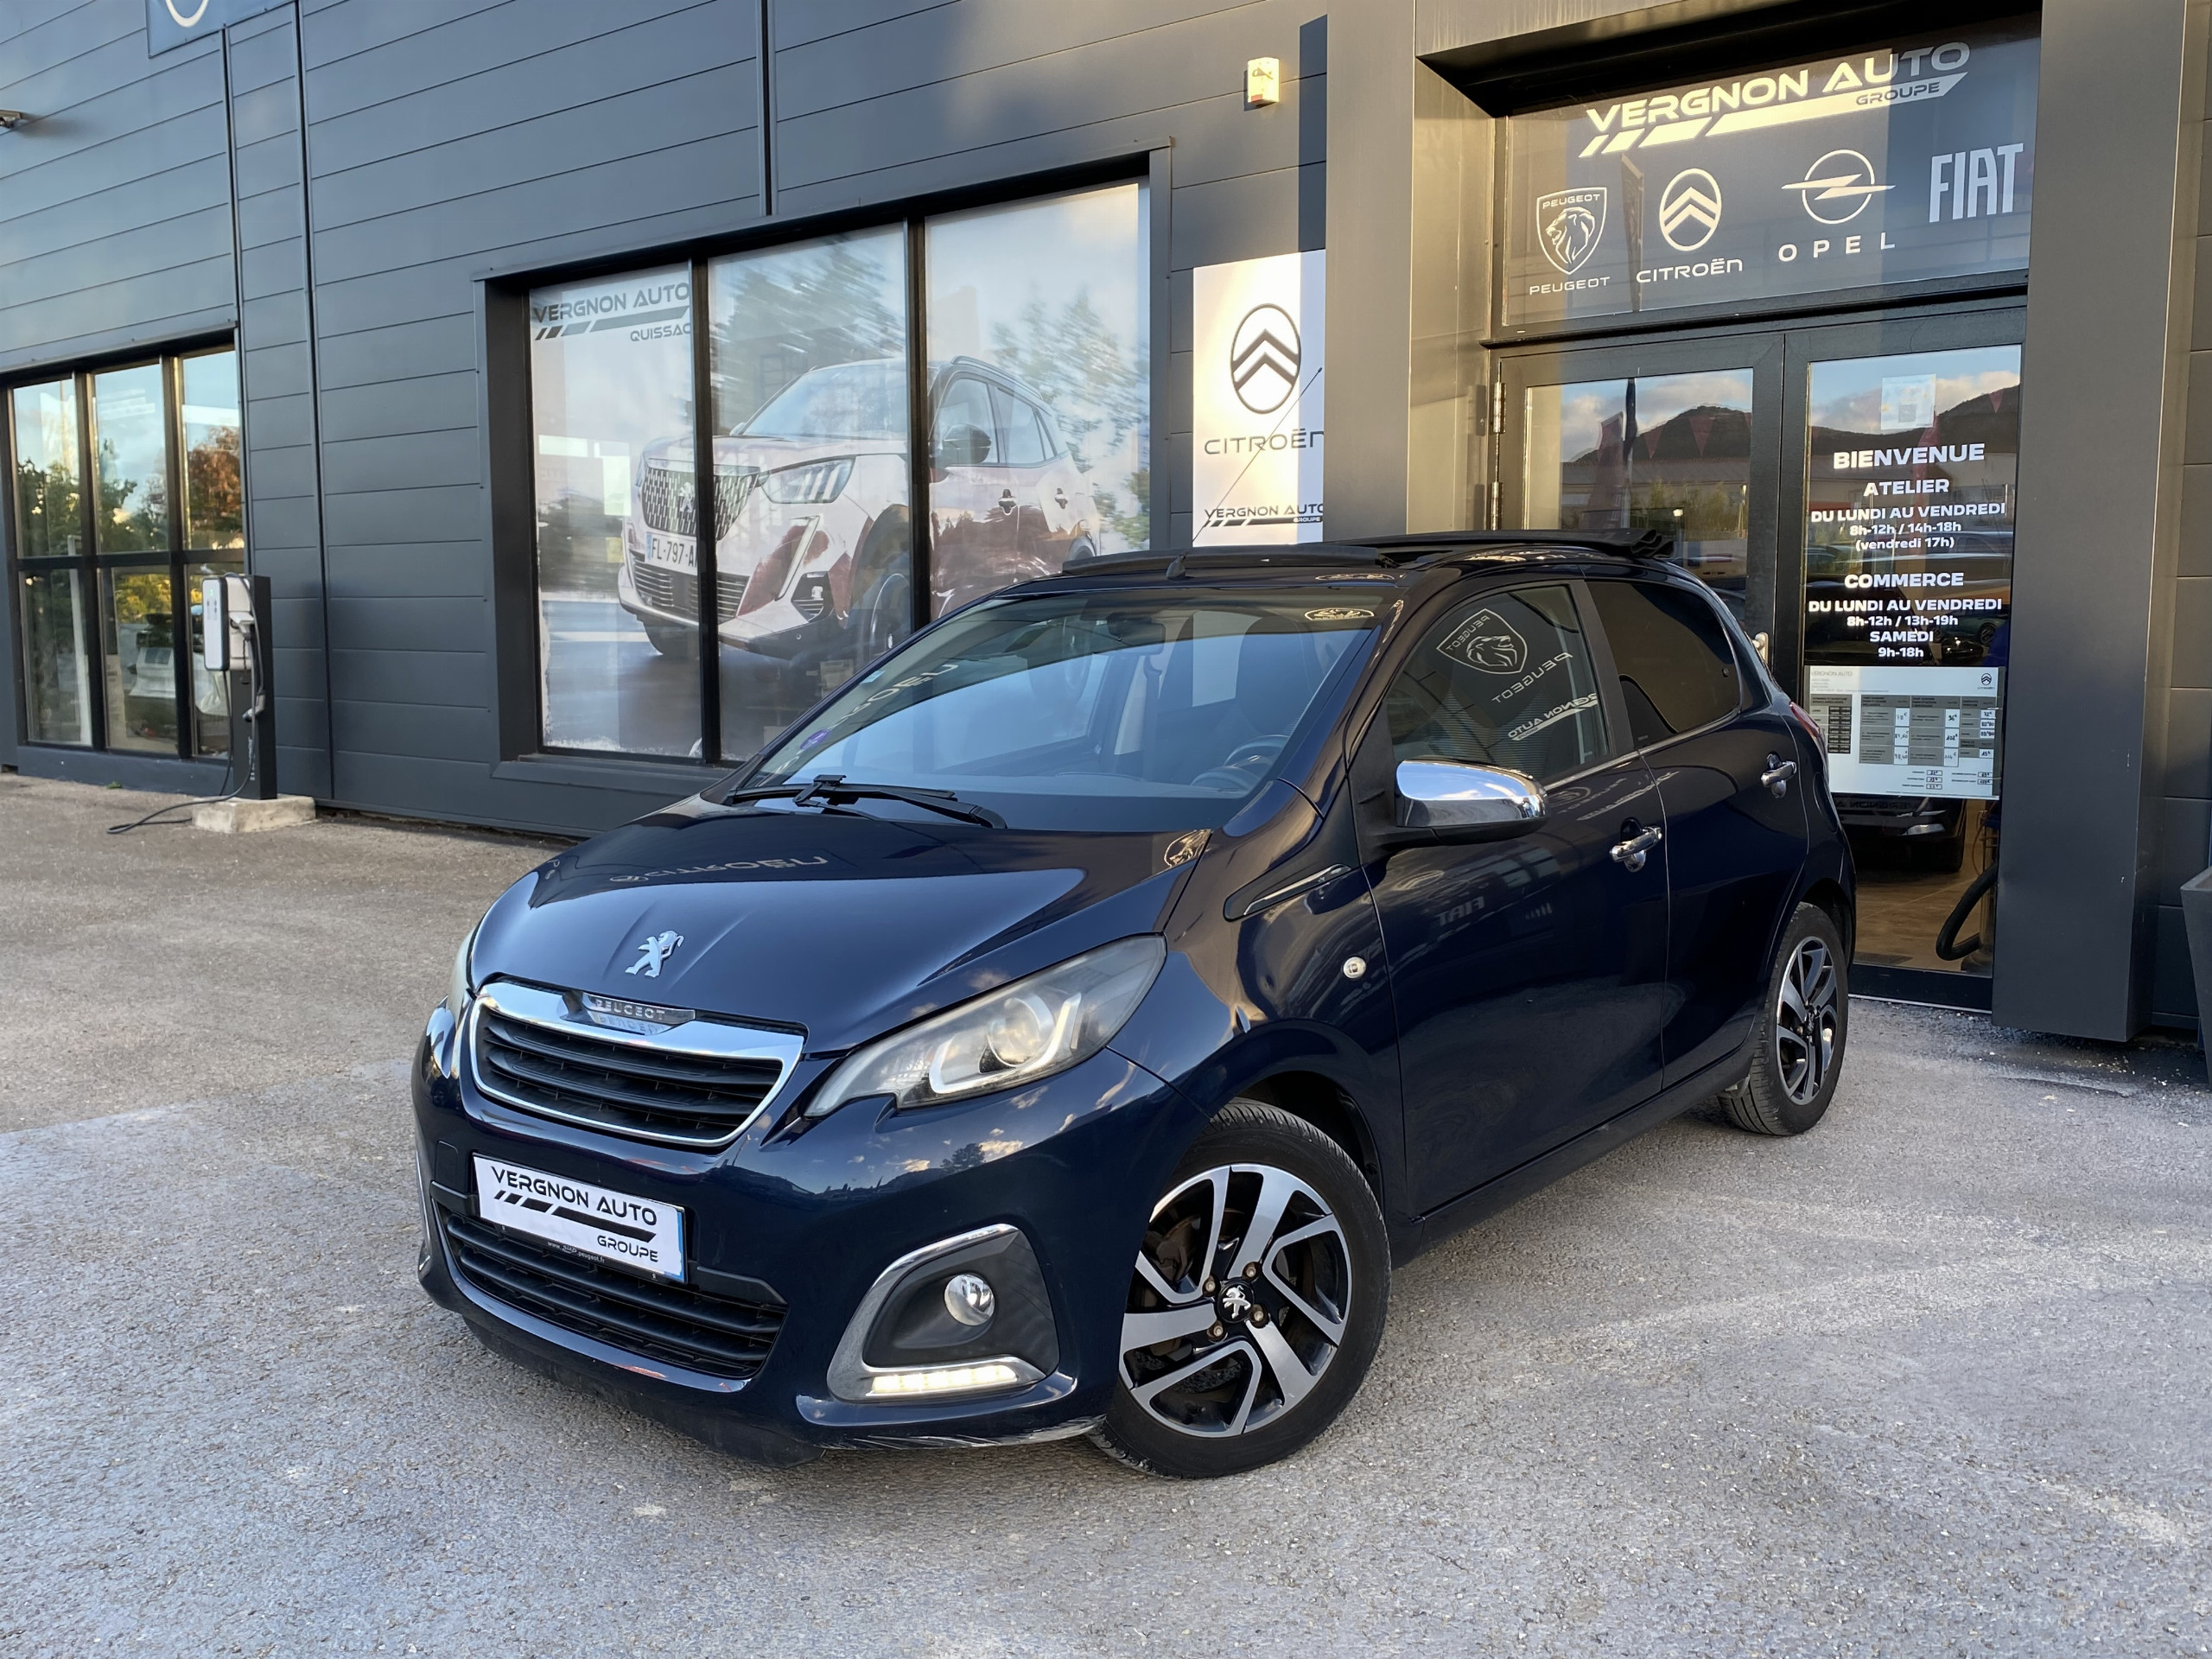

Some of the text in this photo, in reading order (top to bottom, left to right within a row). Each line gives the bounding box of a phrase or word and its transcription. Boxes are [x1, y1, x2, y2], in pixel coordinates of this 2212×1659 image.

[1586, 41, 1970, 132] VERGNON AUTO
[1855, 81, 1941, 106] GROUPE
[1929, 143, 2024, 223] FIAT
[1541, 193, 1601, 210] PEUGEOT
[1778, 232, 1896, 262] OPEL
[1529, 276, 1611, 296] PEUGEOT
[534, 282, 690, 323] VERGNON AUTO
[630, 322, 691, 342] QUISSAC
[1833, 442, 1986, 470] BIENVENUE
[1863, 479, 1949, 497] ATELIER
[1205, 505, 1279, 518] VERGNON
[1810, 502, 2005, 523] DU LUNDI AU VENDREDI
[1849, 524, 1896, 536] 8h-12h
[1907, 521, 1961, 533] 14h-18h
[1855, 537, 1955, 551] (vendredi 17h)
[1844, 572, 1964, 589] COMMERCE
[1808, 598, 2002, 612] DU LUNDI AU VENDREDI
[1847, 616, 1892, 627] 8h-12h
[1904, 614, 1959, 626] 13h-19h
[1869, 630, 1934, 642] SAMEDI
[1878, 646, 1924, 658] 9h-18h
[595, 998, 665, 1020] PEUGEOT
[491, 1166, 658, 1226] VERGNON AUTO
[597, 1235, 658, 1262] GROUPE
